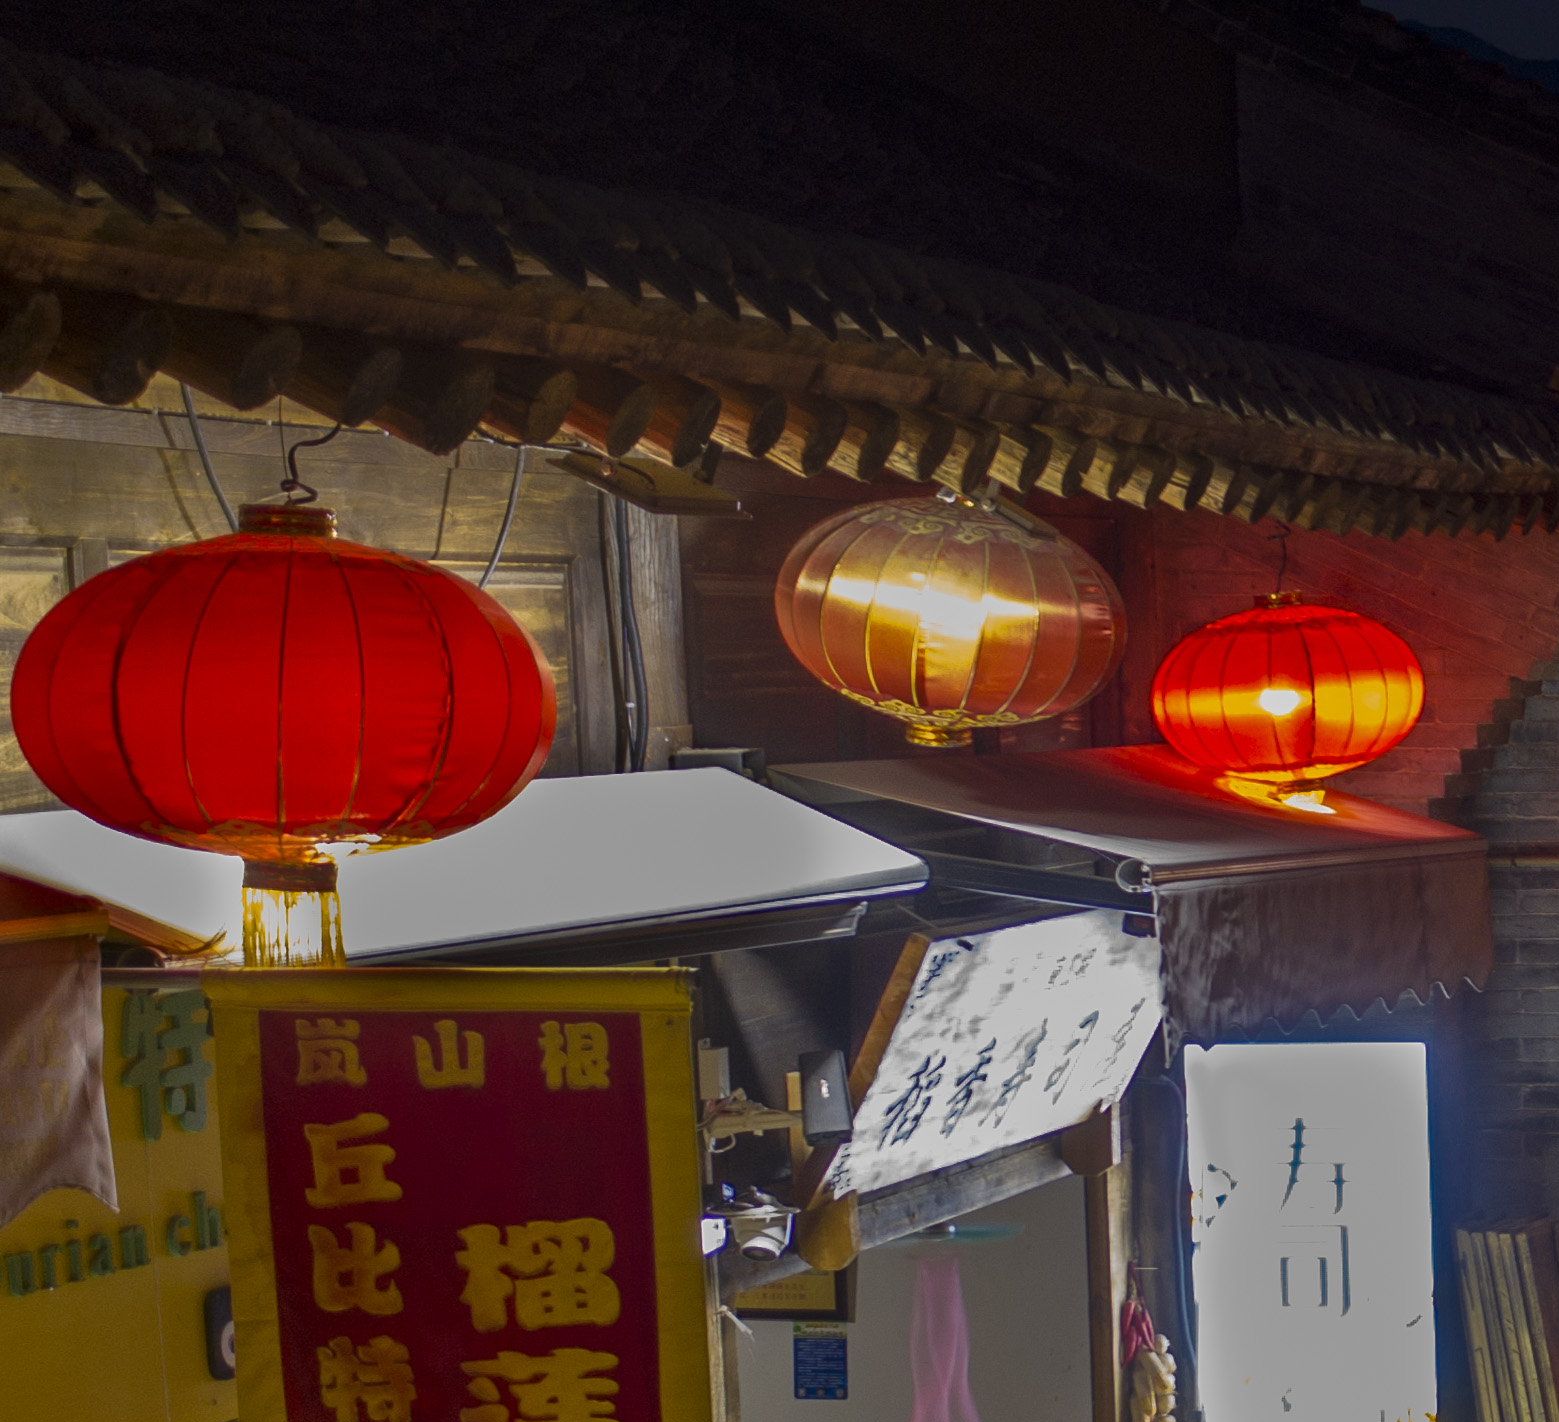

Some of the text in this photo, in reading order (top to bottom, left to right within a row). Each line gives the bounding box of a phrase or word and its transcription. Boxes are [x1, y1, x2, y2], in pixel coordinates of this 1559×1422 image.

[294, 1018, 611, 1091] 岚山根
[0, 1219, 151, 1298] urian
